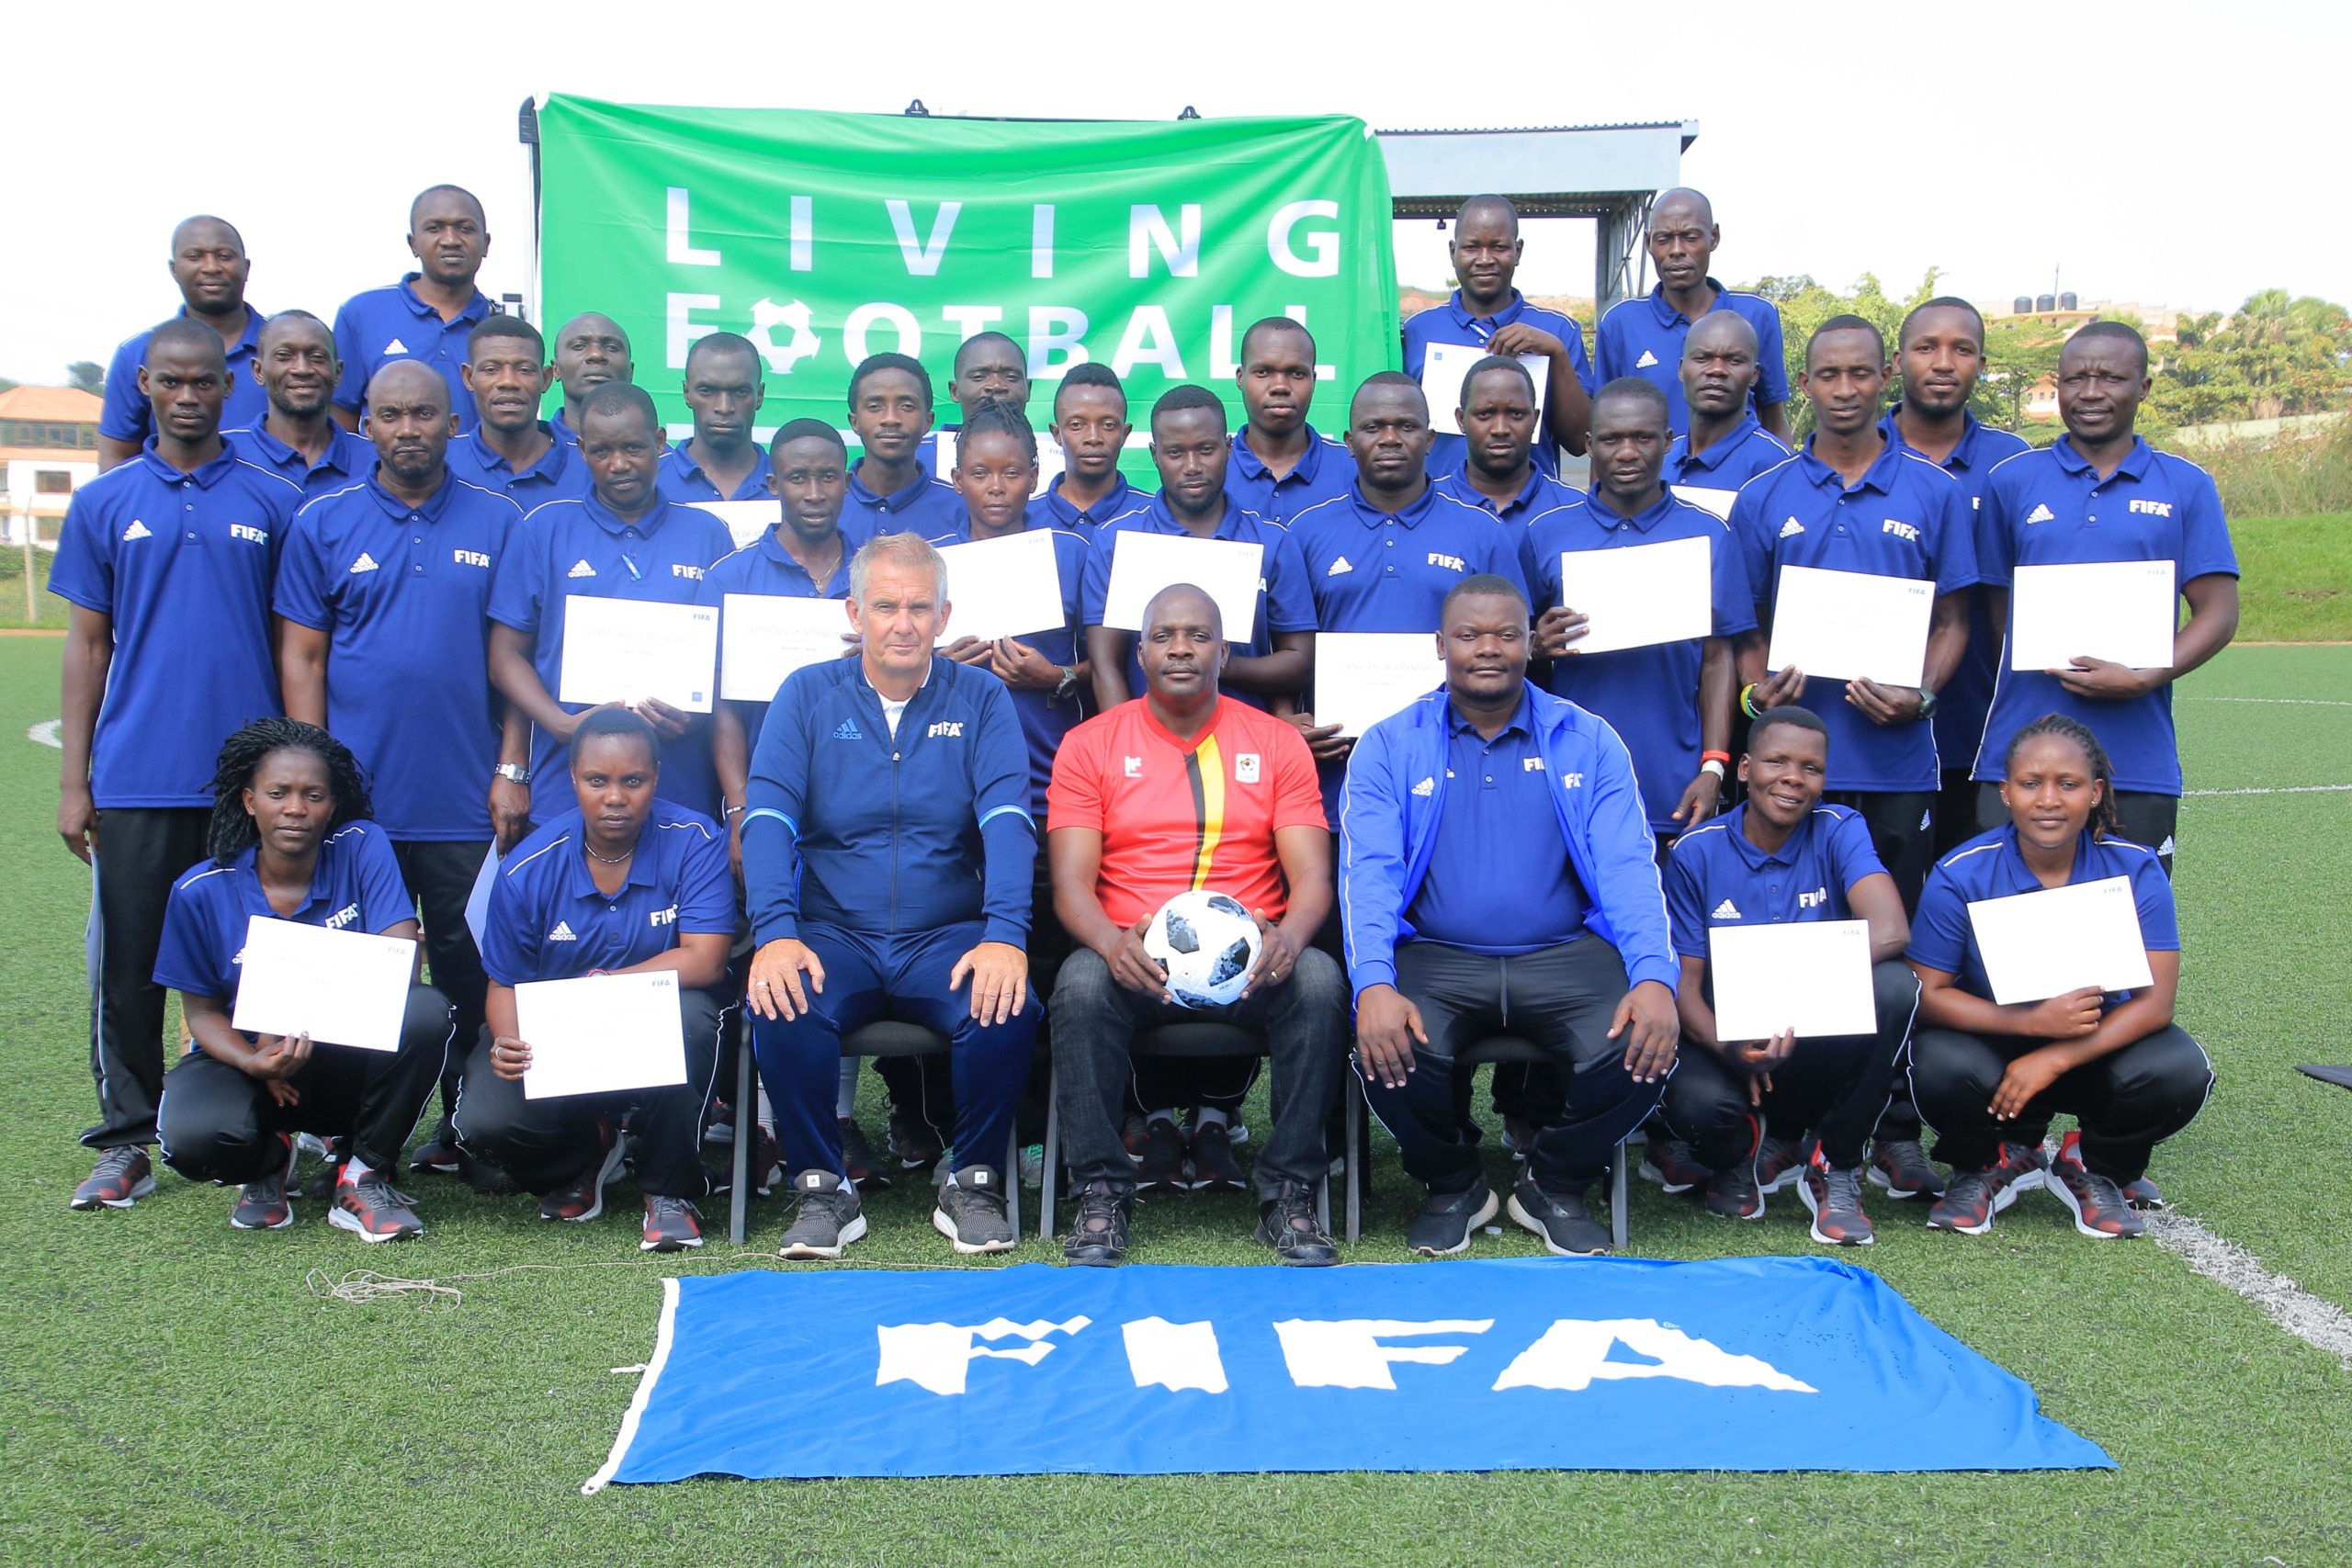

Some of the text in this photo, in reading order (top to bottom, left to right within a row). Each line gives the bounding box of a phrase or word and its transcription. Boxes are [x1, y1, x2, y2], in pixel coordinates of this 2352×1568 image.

[666, 186, 1340, 278] LIVING
[2129, 500, 2170, 518] FIFA
[2027, 513, 2055, 525] adidas
[122, 529, 153, 542] adidas
[230, 523, 266, 546] FIFA
[1883, 518, 1917, 542] FIFA
[350, 562, 379, 573] adidas
[454, 549, 491, 569] FIFA
[1427, 551, 1464, 572] FIFA
[568, 569, 596, 578] adidas
[672, 564, 705, 581] FIFA
[693, 613, 711, 622] FIFA
[832, 729, 863, 739] adidas
[927, 721, 962, 739] FIFA
[324, 905, 359, 930] FIFA
[1711, 911, 1742, 919] adidas
[548, 932, 577, 941] adidas
[651, 978, 671, 987] FIFA
[876, 1314, 1820, 1396] FIFA
